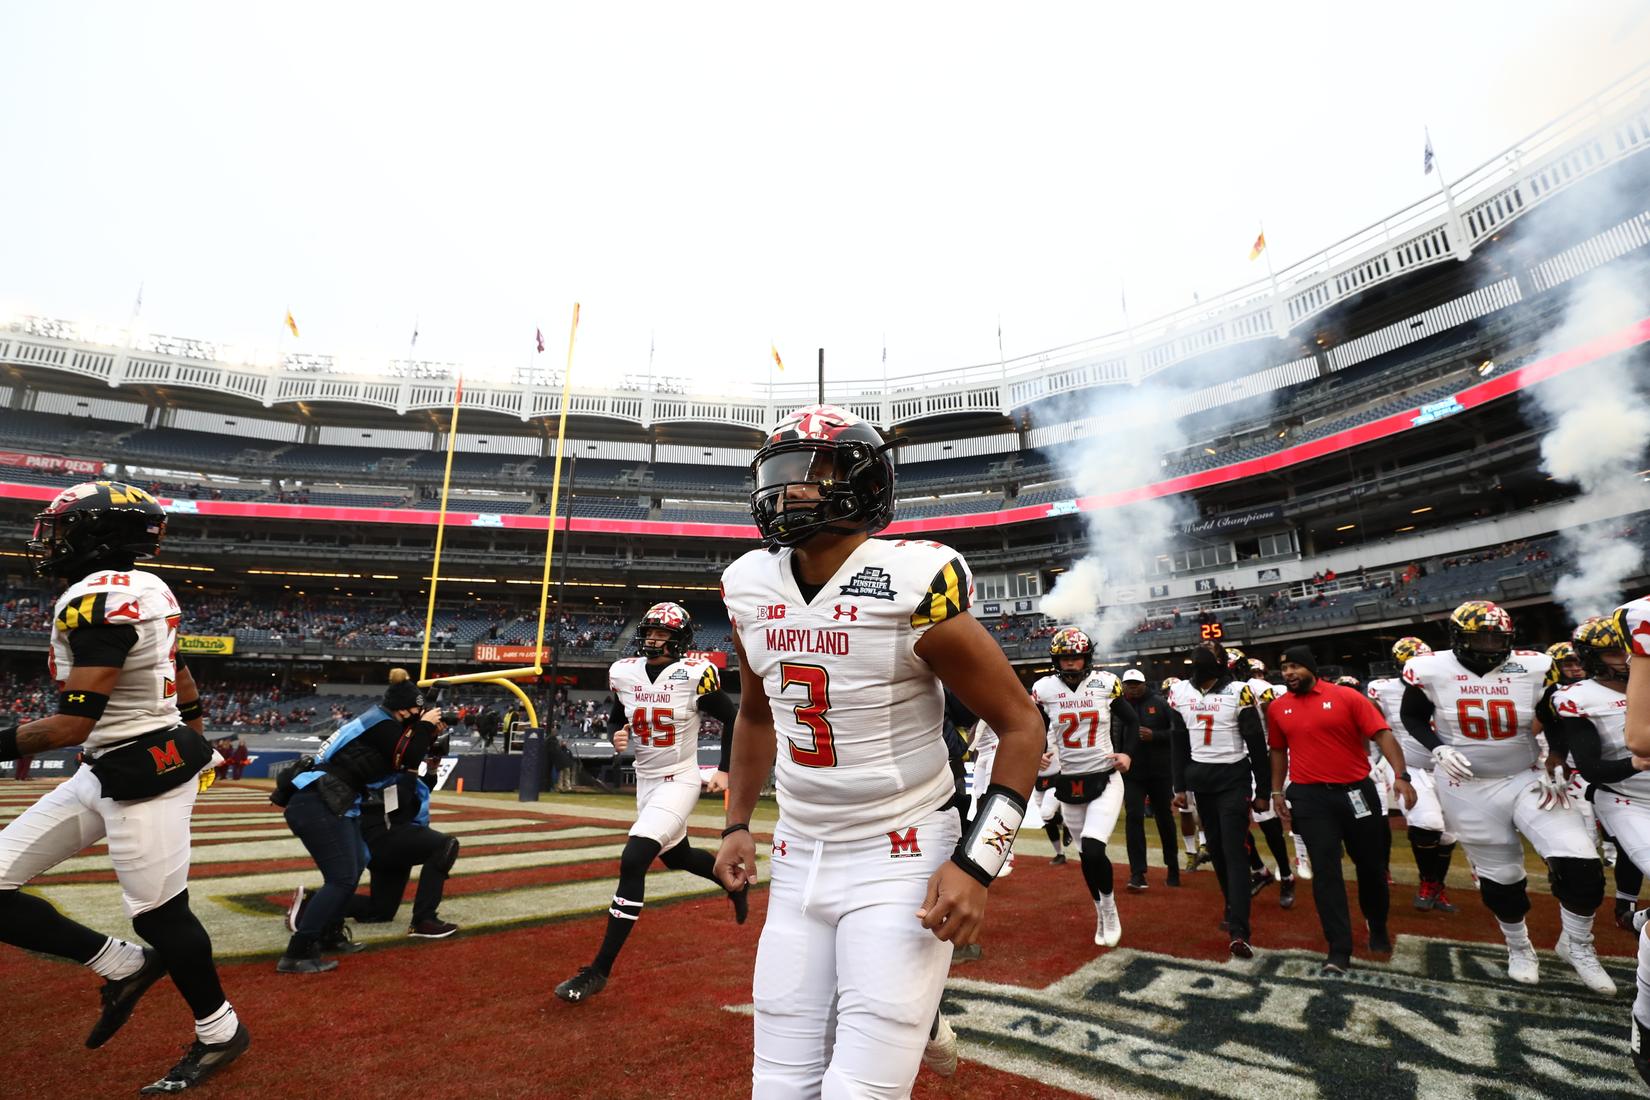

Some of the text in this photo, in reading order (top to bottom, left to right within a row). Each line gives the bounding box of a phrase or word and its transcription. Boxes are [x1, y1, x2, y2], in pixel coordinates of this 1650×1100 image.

[26, 456, 63, 468] PARTY
[64, 460, 96, 472] DECK
[1182, 521, 1214, 535] World
[1217, 511, 1274, 529] Champions
[853, 579, 888, 589] PINSTRIPE
[765, 628, 849, 656] MARYLAND
[1201, 623, 1222, 639] 25
[478, 646, 501, 661] JBL
[635, 693, 671, 704] MARYLAND
[1460, 685, 1509, 696] MARYLAND
[779, 661, 838, 768] 3
[1060, 699, 1094, 709] MARYLAND
[632, 706, 676, 748] 45
[1058, 710, 1100, 748] 27
[1196, 714, 1215, 746] 7
[1456, 698, 1519, 741] 60
[43, 760, 65, 769] HERE
[148, 739, 184, 772] M
[887, 826, 922, 855] M
